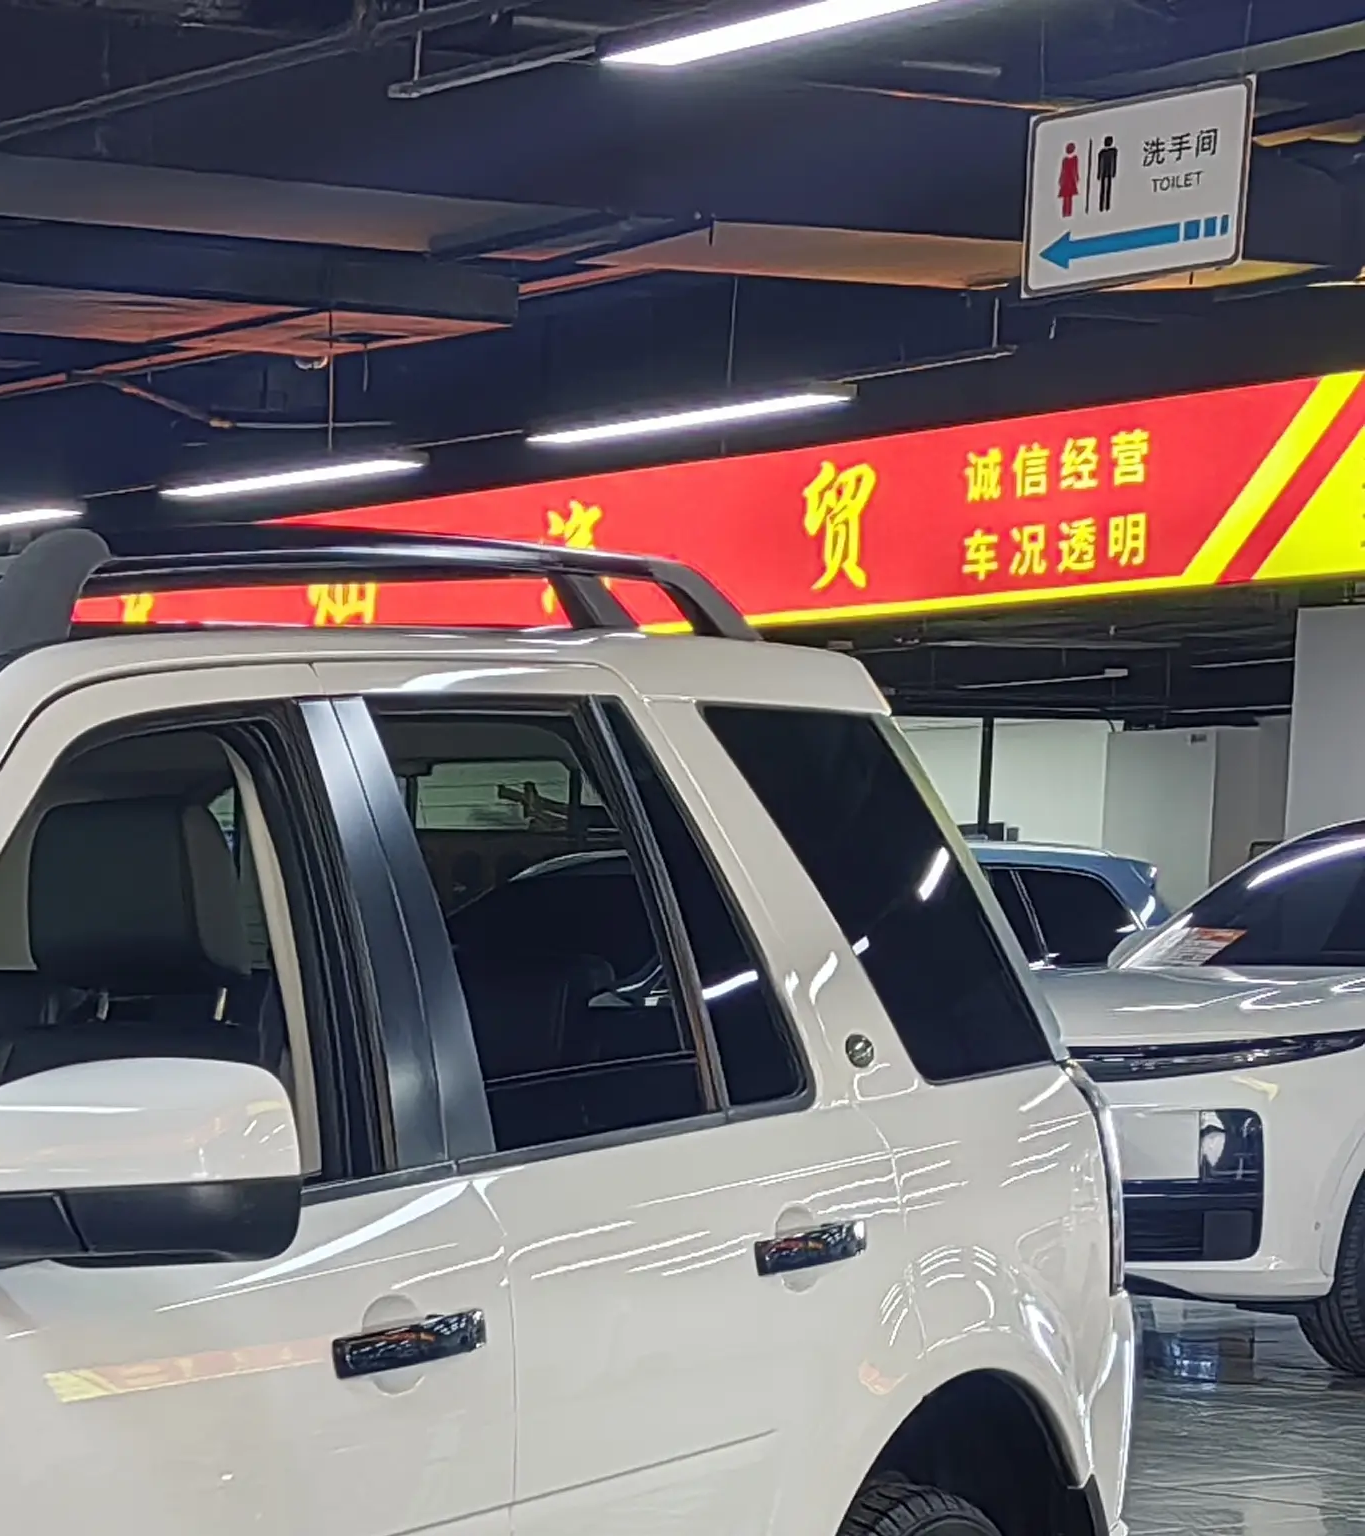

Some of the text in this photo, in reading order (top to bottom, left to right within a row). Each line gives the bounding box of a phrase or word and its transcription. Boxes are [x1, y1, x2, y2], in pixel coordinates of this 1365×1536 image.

[1142, 128, 1218, 167] 洗手间
[1151, 170, 1204, 193] TOILET
[965, 429, 1150, 502] 诚信经营
[961, 512, 1147, 580] 车况透明
